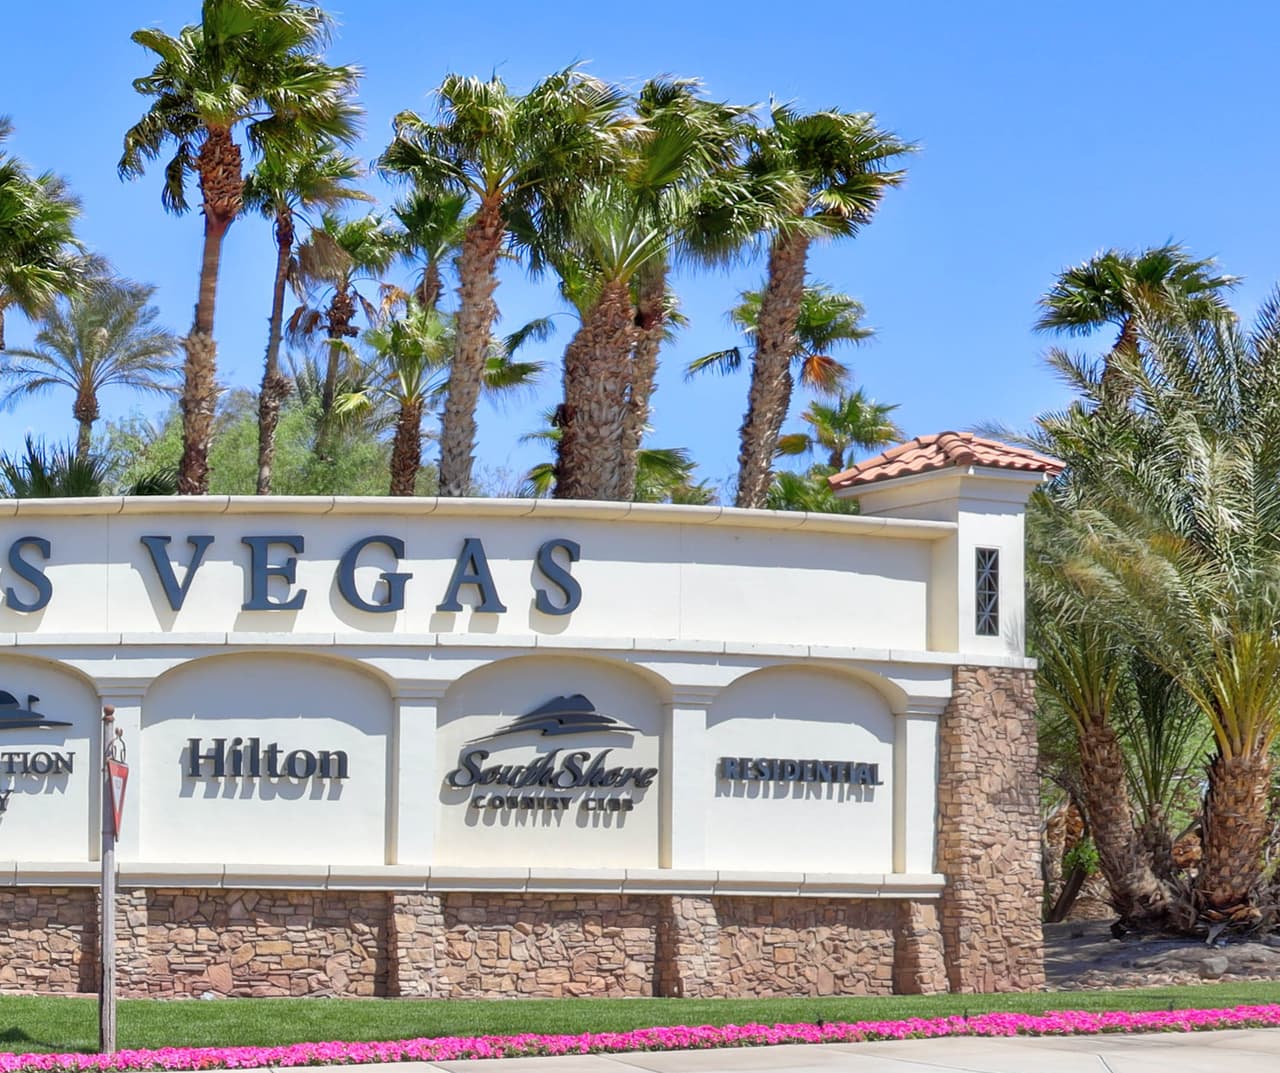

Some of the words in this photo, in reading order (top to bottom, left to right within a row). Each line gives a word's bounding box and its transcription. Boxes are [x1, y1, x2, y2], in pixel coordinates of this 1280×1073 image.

[139, 534, 582, 616] VEGAS
[187, 737, 350, 779] Hilton
[718, 756, 884, 786] RESIDENTIAL
[472, 795, 572, 811] COUNTRY
[585, 797, 634, 811] CLUB
